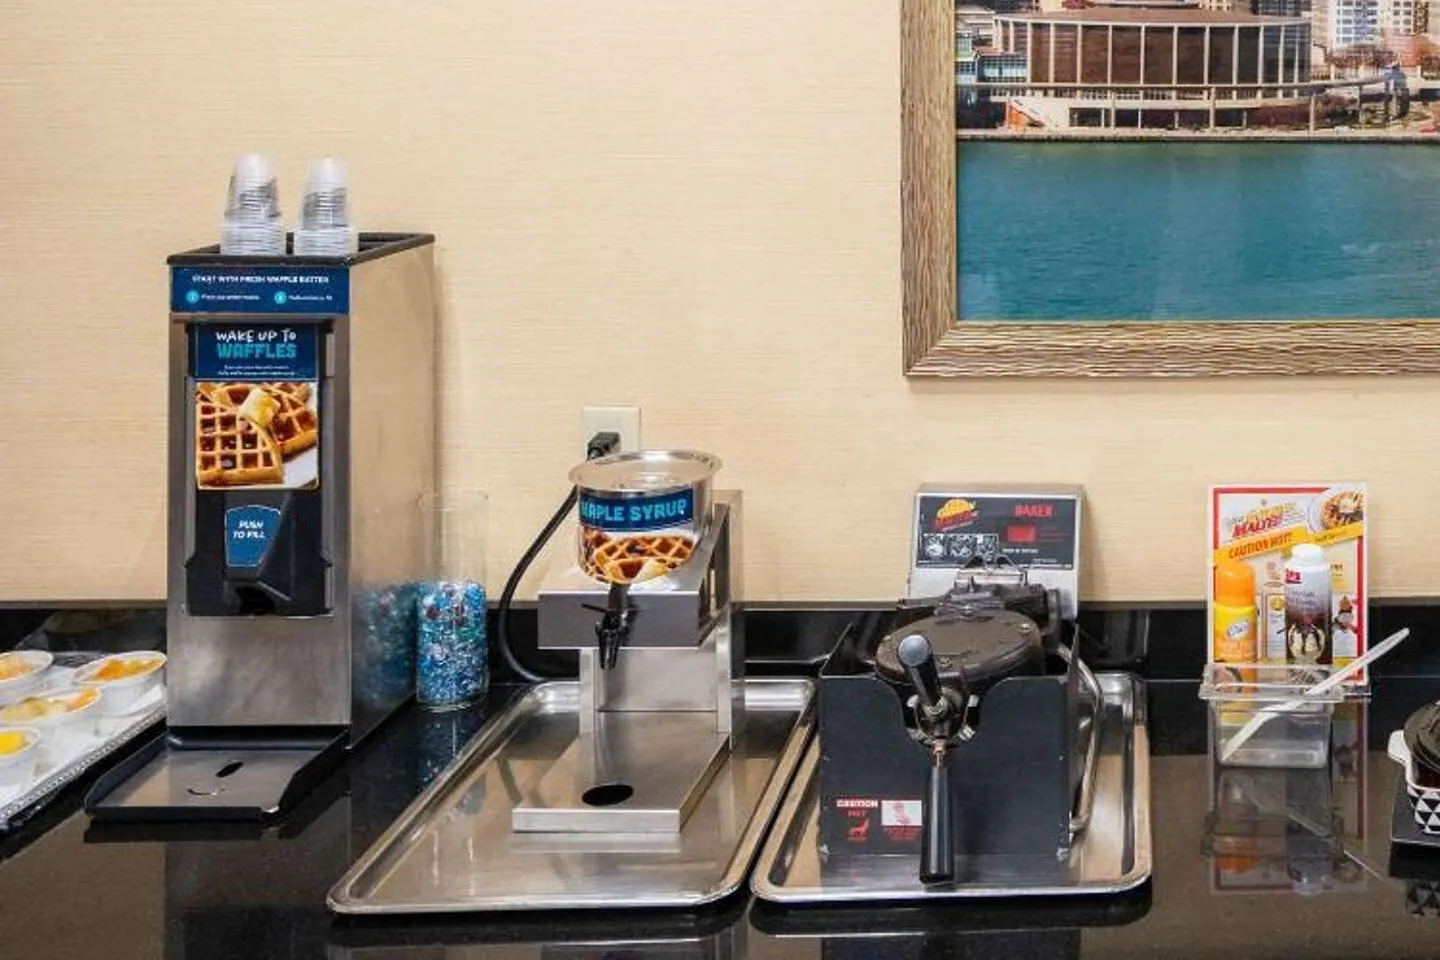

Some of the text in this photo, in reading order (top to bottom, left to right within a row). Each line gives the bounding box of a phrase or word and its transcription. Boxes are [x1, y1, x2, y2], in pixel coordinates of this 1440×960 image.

[215, 329, 254, 343] WAKE
[258, 330, 278, 342] UP
[216, 343, 297, 358] WAFFLES
[581, 498, 687, 522] MAPLE SYRUP
[233, 530, 246, 539] TO
[1228, 539, 1269, 559] CAUTION
